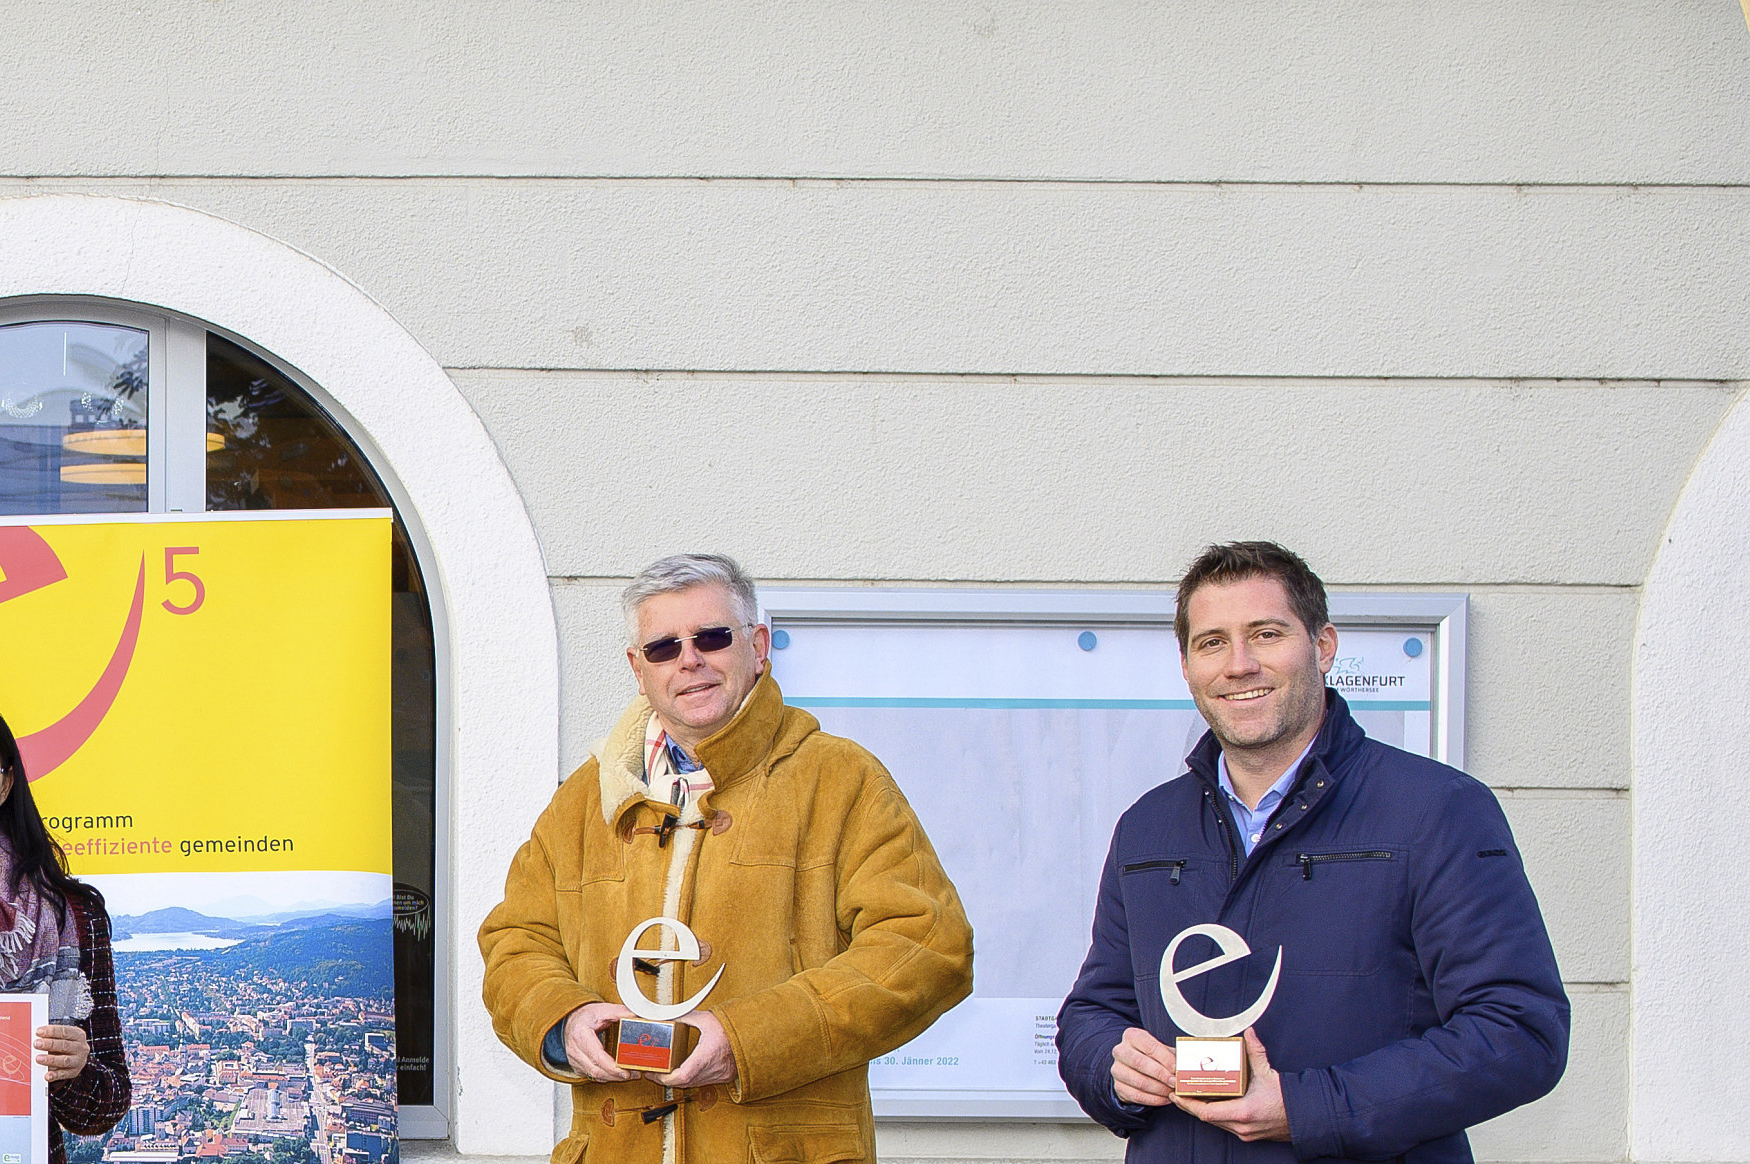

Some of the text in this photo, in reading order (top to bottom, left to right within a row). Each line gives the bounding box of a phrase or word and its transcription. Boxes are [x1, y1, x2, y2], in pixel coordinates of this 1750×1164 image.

[179, 835, 294, 856] gemeinden
[884, 1056, 898, 1065] 30.
[901, 1056, 933, 1065] Jänner
[937, 1057, 959, 1065] 2022
